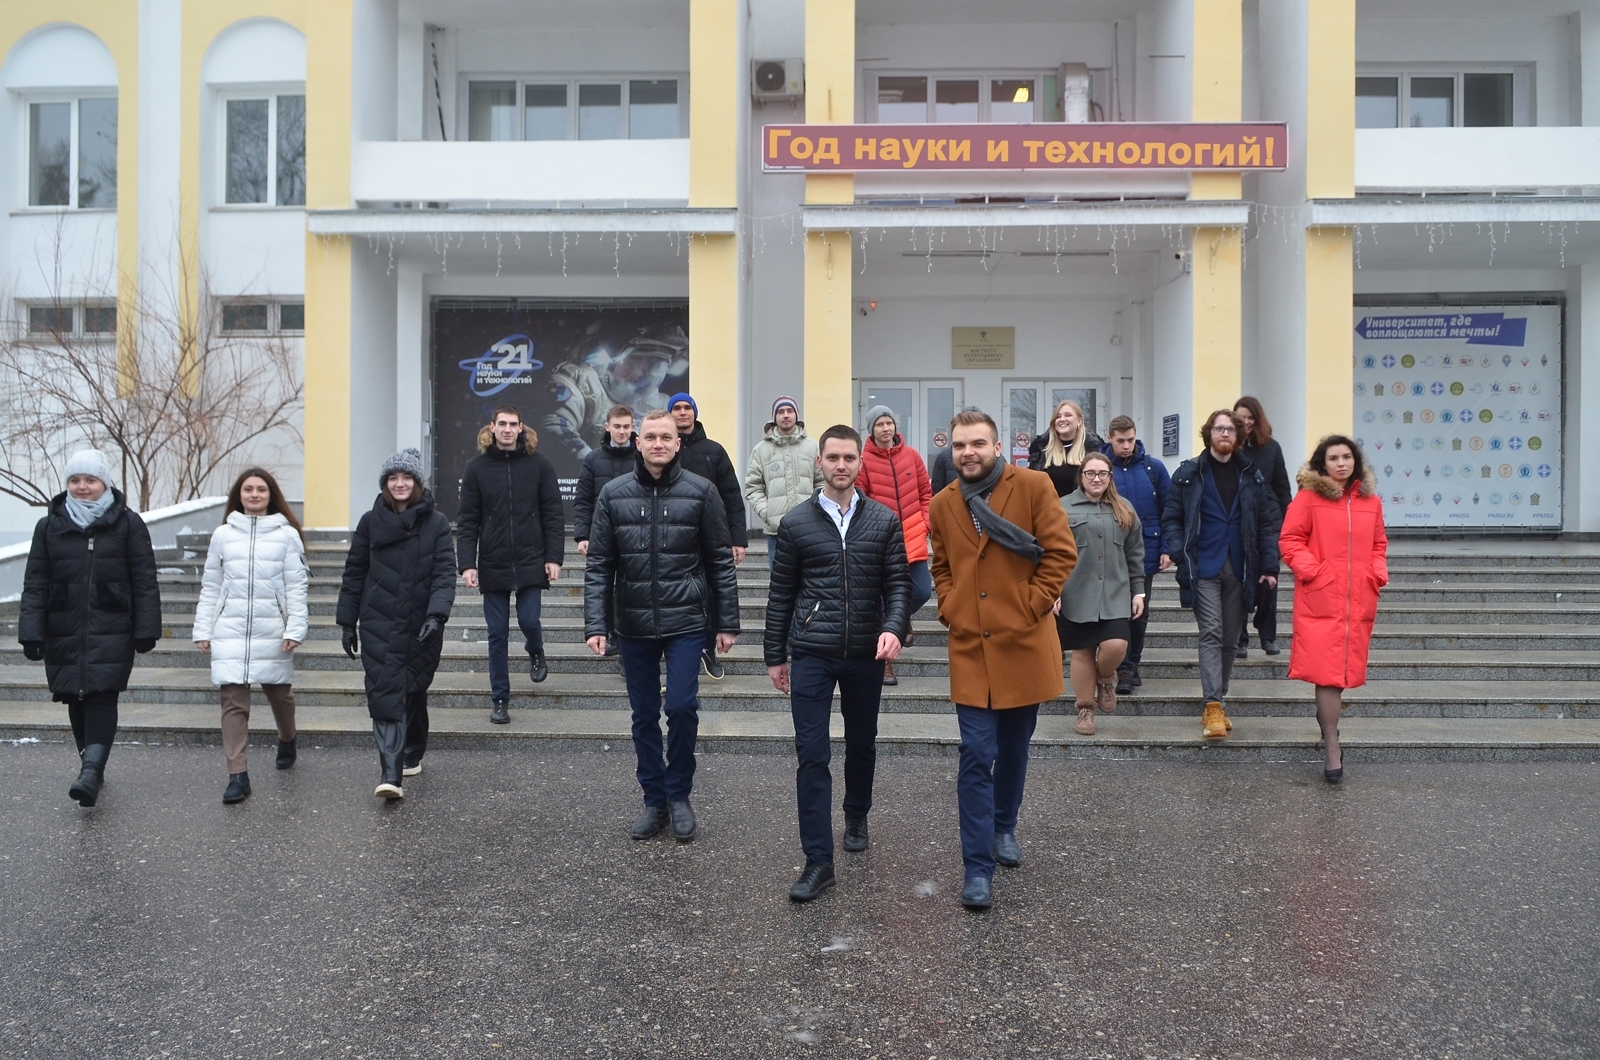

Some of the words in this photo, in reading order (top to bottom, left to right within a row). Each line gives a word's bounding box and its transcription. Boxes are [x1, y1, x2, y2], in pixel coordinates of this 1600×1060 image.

[768, 129, 840, 165] Год
[854, 134, 971, 169] науки
[986, 136, 1009, 163] и
[1022, 136, 1275, 167] технологий!
[1366, 317, 1446, 329] Университет,
[1450, 315, 1472, 326] где
[1366, 328, 1447, 339] воплощаются
[1449, 325, 1500, 337] мечты!
[477, 362, 493, 371] Год
[477, 370, 503, 378] науки
[484, 375, 532, 384] технологий
